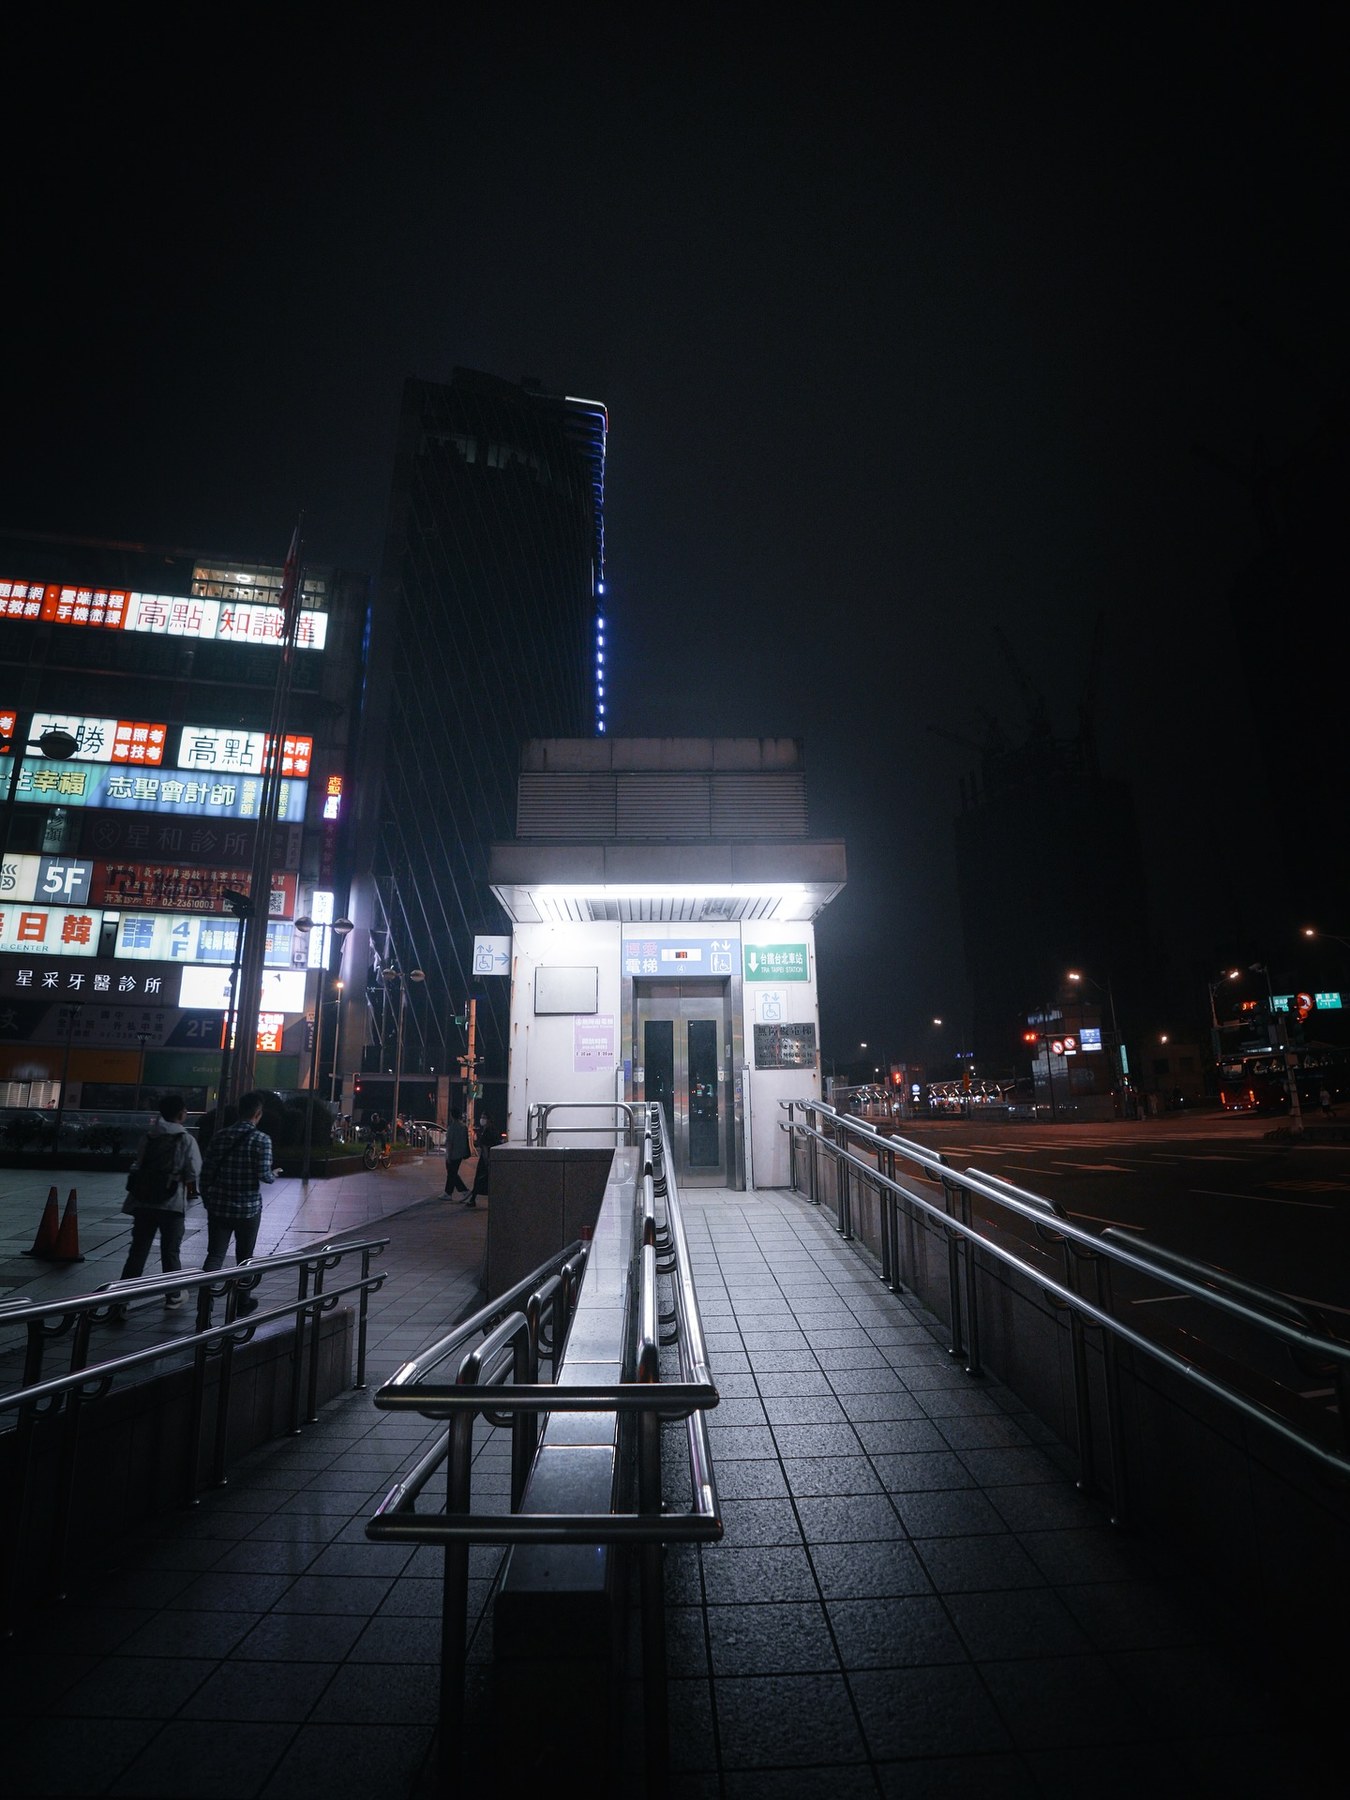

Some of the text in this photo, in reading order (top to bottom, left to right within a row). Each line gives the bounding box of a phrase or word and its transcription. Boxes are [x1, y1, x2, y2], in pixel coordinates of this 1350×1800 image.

[188, 735, 256, 767] 高點
[0, 768, 87, 796] 生幸福
[107, 776, 236, 807] 志聖會計師
[127, 814, 249, 846] 星和診所
[42, 866, 86, 894] 5F
[0, 912, 92, 945] 日韓
[625, 958, 658, 974] 電梯
[16, 969, 162, 994] 星采牙醫診所
[186, 1019, 214, 1037] 2F
